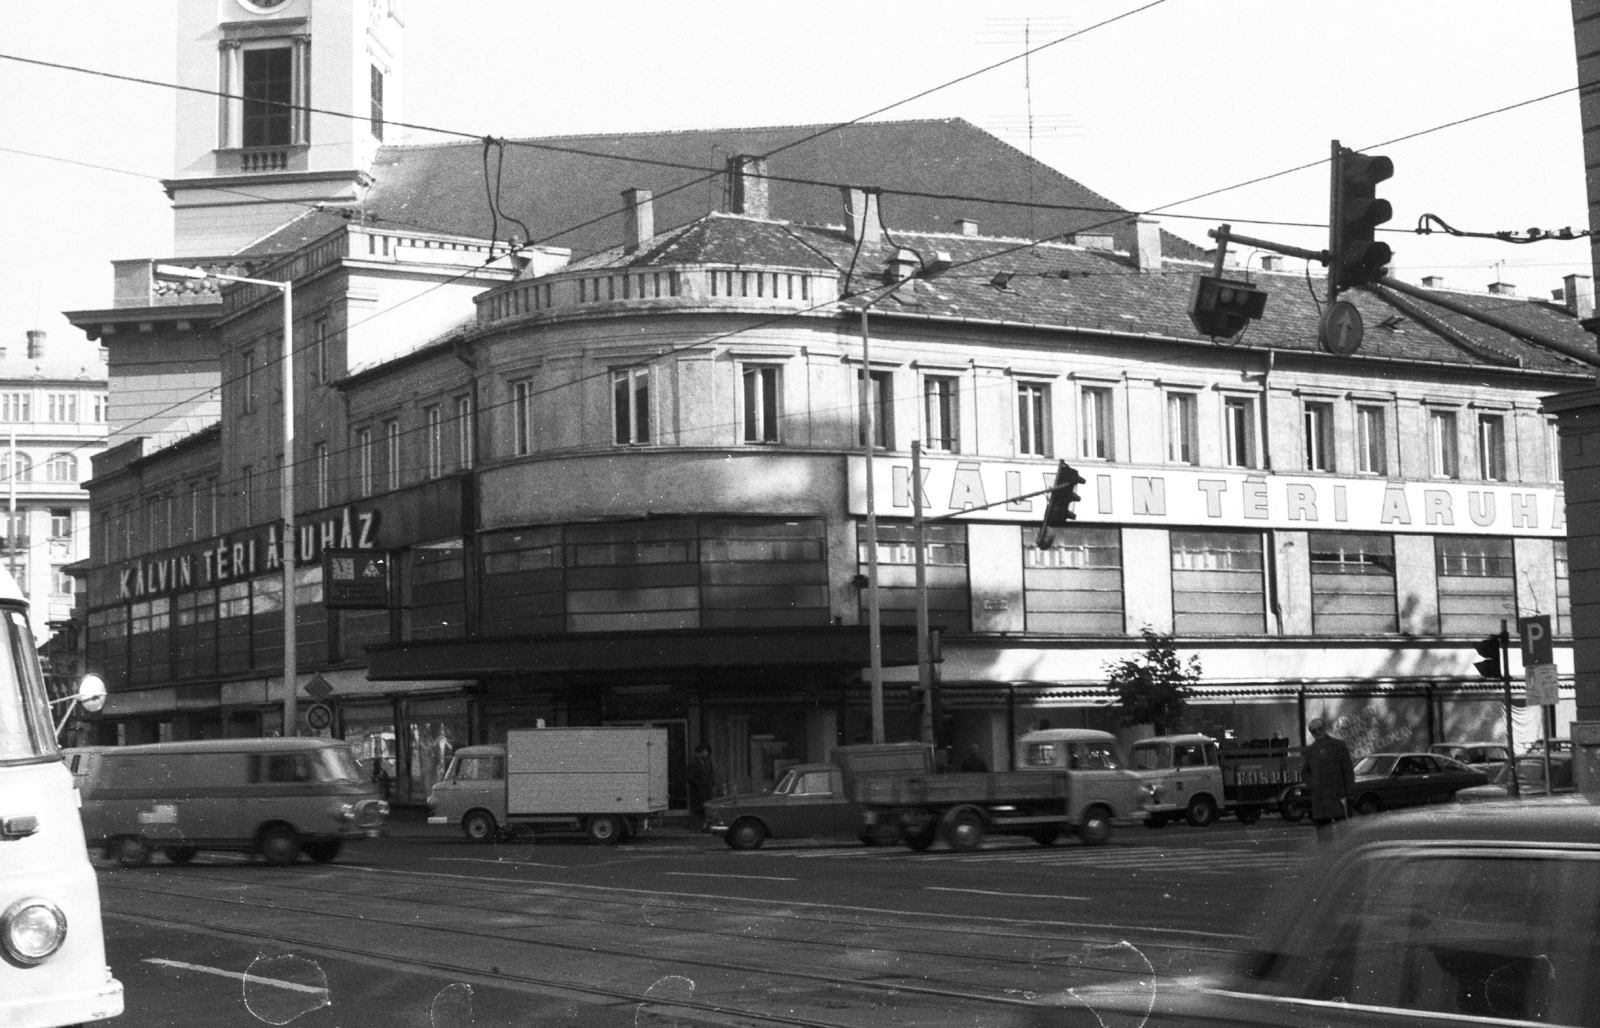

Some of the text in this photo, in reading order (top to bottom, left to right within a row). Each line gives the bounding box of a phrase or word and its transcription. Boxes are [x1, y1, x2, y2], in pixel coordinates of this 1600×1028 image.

[1198, 475, 1348, 522] TÉRI
[120, 508, 372, 598] KÁLVIN TÉRI ÁUHÁZ
[1527, 622, 1544, 655] P
